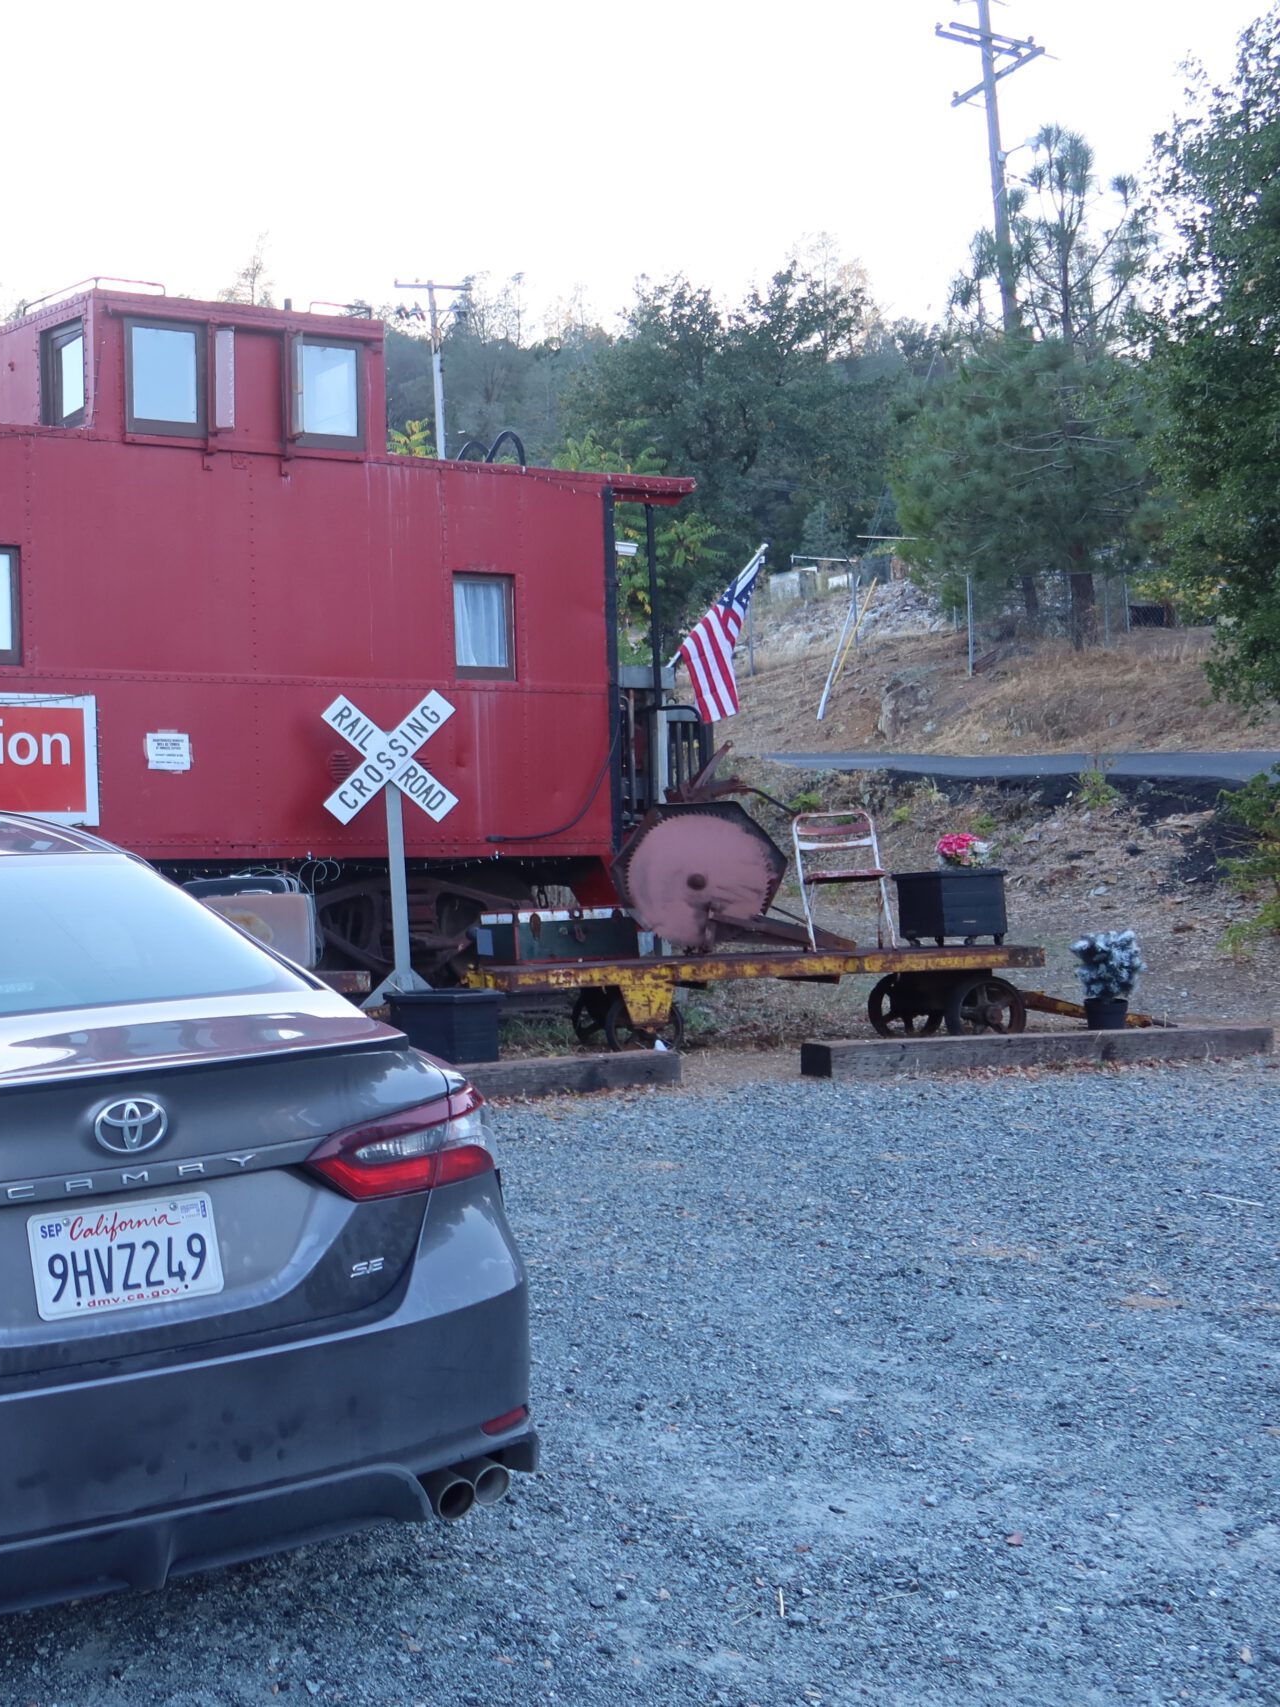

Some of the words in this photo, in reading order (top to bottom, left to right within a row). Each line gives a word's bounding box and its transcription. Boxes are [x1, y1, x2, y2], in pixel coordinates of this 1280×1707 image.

[331, 705, 375, 752] RAIL
[338, 705, 441, 810] CROSSING
[398, 765, 447, 811] ROAD
[6, 1154, 256, 1201] CAMRY
[40, 1223, 62, 1239] SEP
[70, 1211, 181, 1242] California
[47, 1233, 207, 1303] 9HVZ249
[350, 1257, 384, 1278] SE
[87, 1287, 180, 1308] dmv.ca.gov
